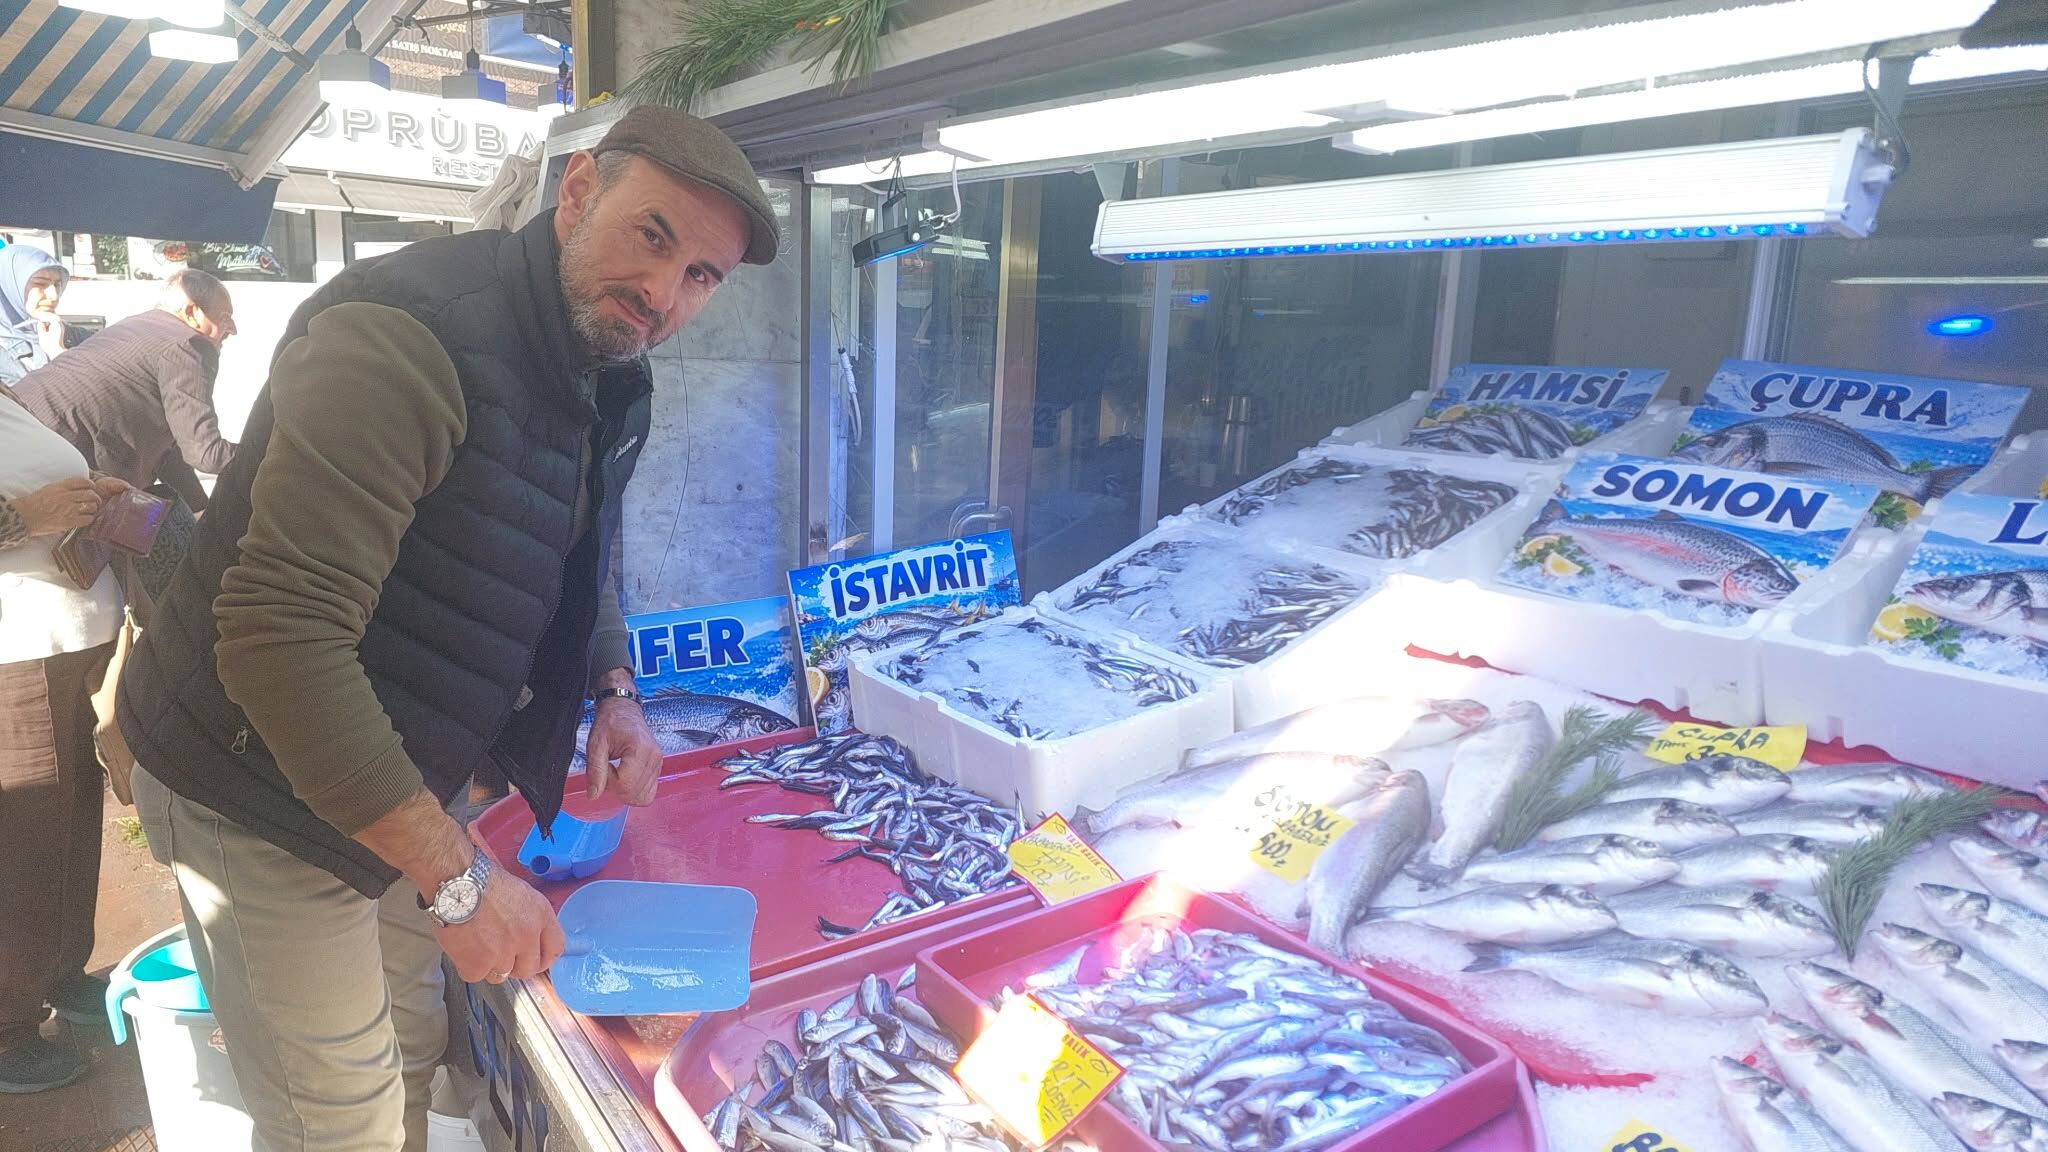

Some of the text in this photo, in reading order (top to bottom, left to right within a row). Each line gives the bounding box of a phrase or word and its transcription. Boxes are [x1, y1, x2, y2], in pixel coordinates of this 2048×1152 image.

[420, 44, 462, 59] NOKTASI
[1467, 369, 1629, 408] HAMSİ
[1749, 373, 1949, 426] ÇUPRA
[1592, 464, 1829, 530] SOMON
[831, 541, 988, 618] İSTAVRİT
